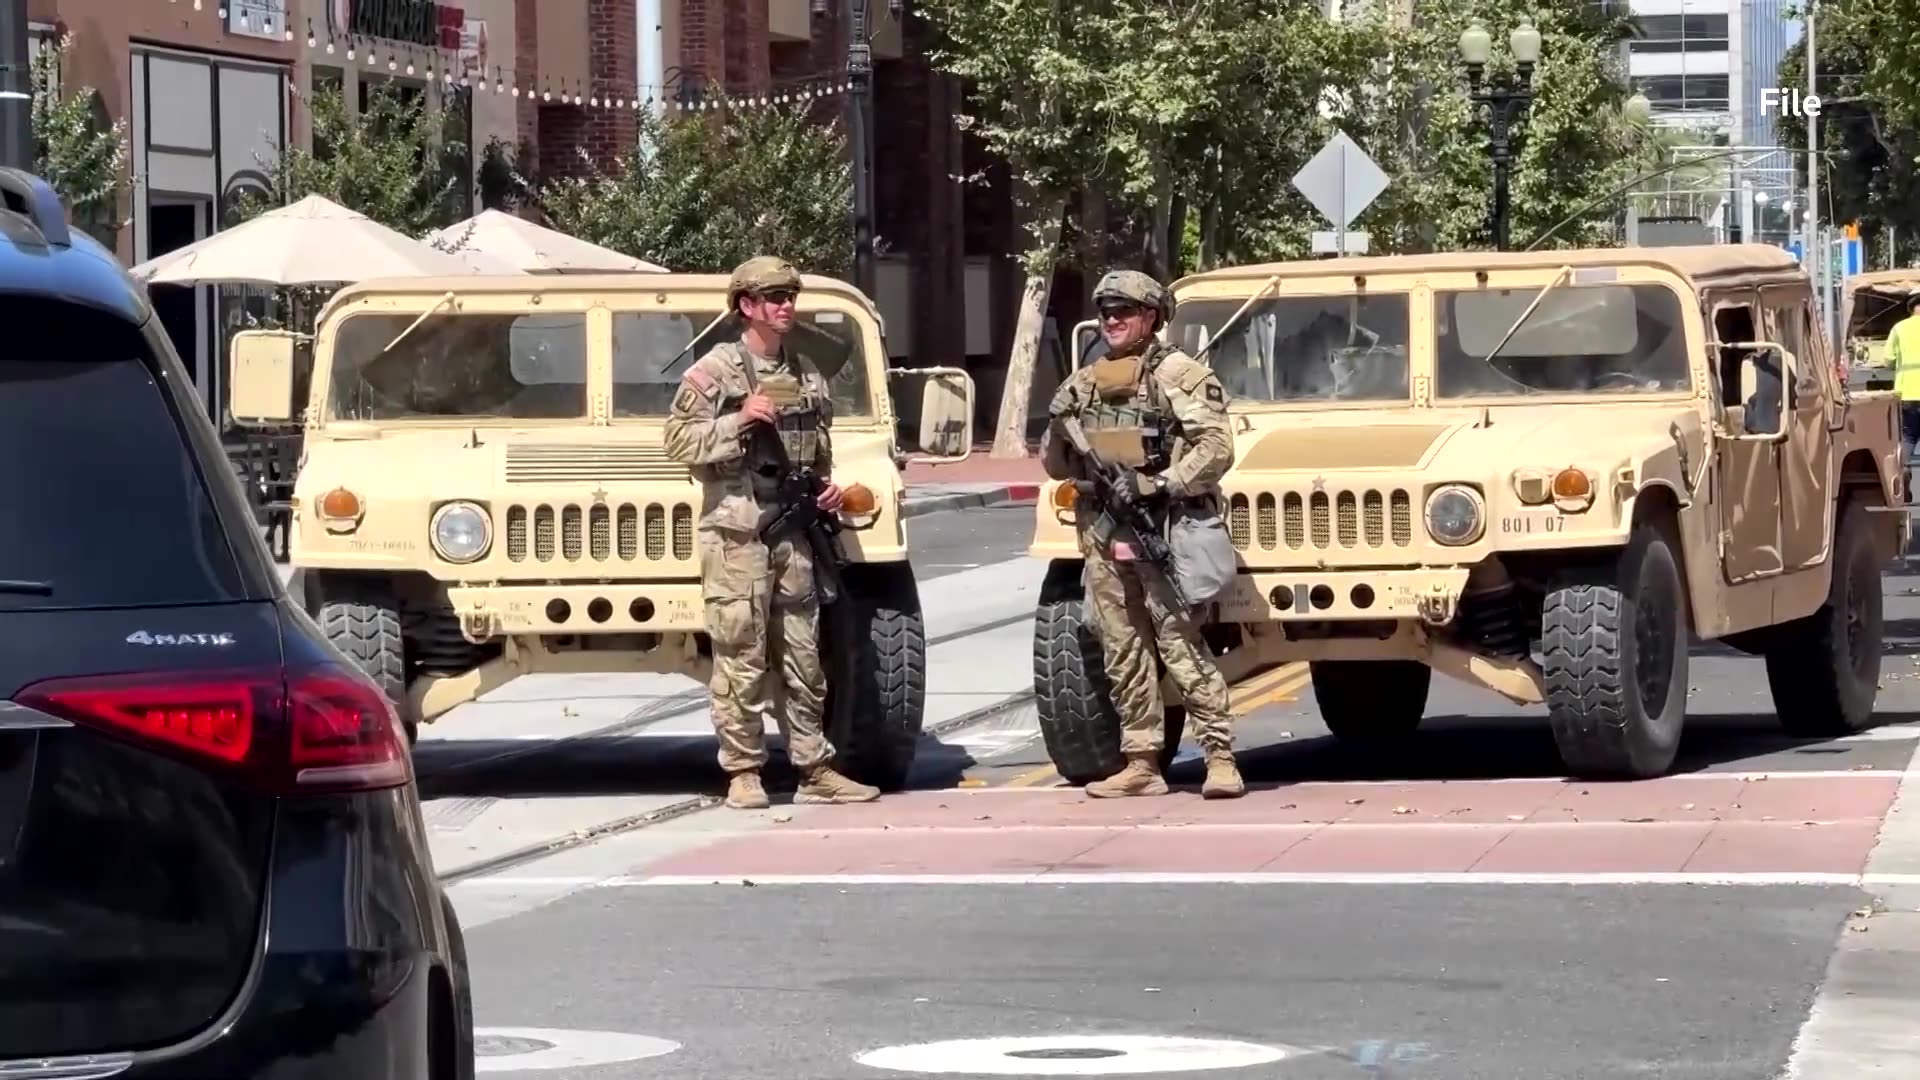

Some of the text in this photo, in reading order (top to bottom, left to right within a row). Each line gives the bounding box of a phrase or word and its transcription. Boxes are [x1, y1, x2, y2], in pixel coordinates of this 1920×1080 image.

[1502, 516, 1565, 534] 801 07
[126, 630, 237, 645] 4MATIC
